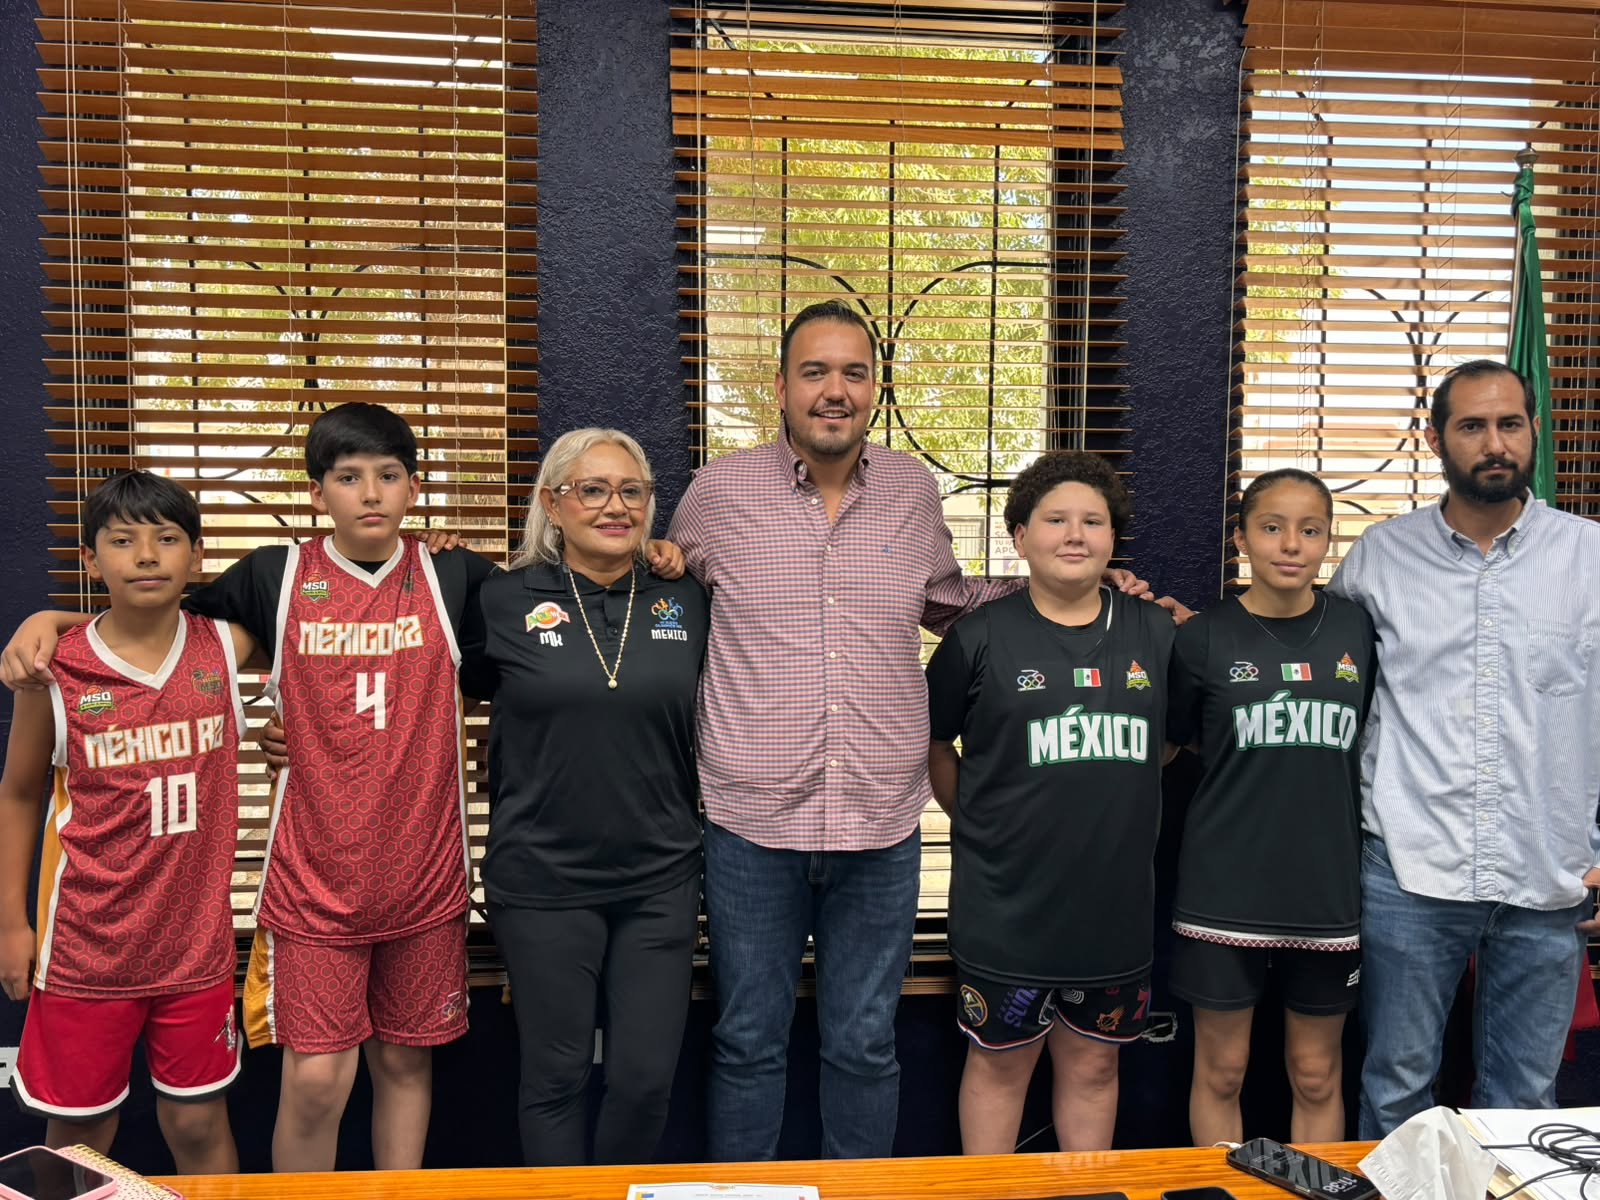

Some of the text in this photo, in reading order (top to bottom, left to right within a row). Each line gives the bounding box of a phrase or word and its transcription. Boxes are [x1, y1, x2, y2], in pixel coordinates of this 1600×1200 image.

[651, 629, 688, 642] MEXICO
[356, 672, 386, 730] 4
[1233, 690, 1358, 752] MÉXICO
[84, 723, 193, 769] MÉXICO
[1028, 704, 1149, 767] MÉXICO
[144, 772, 197, 837] 10
